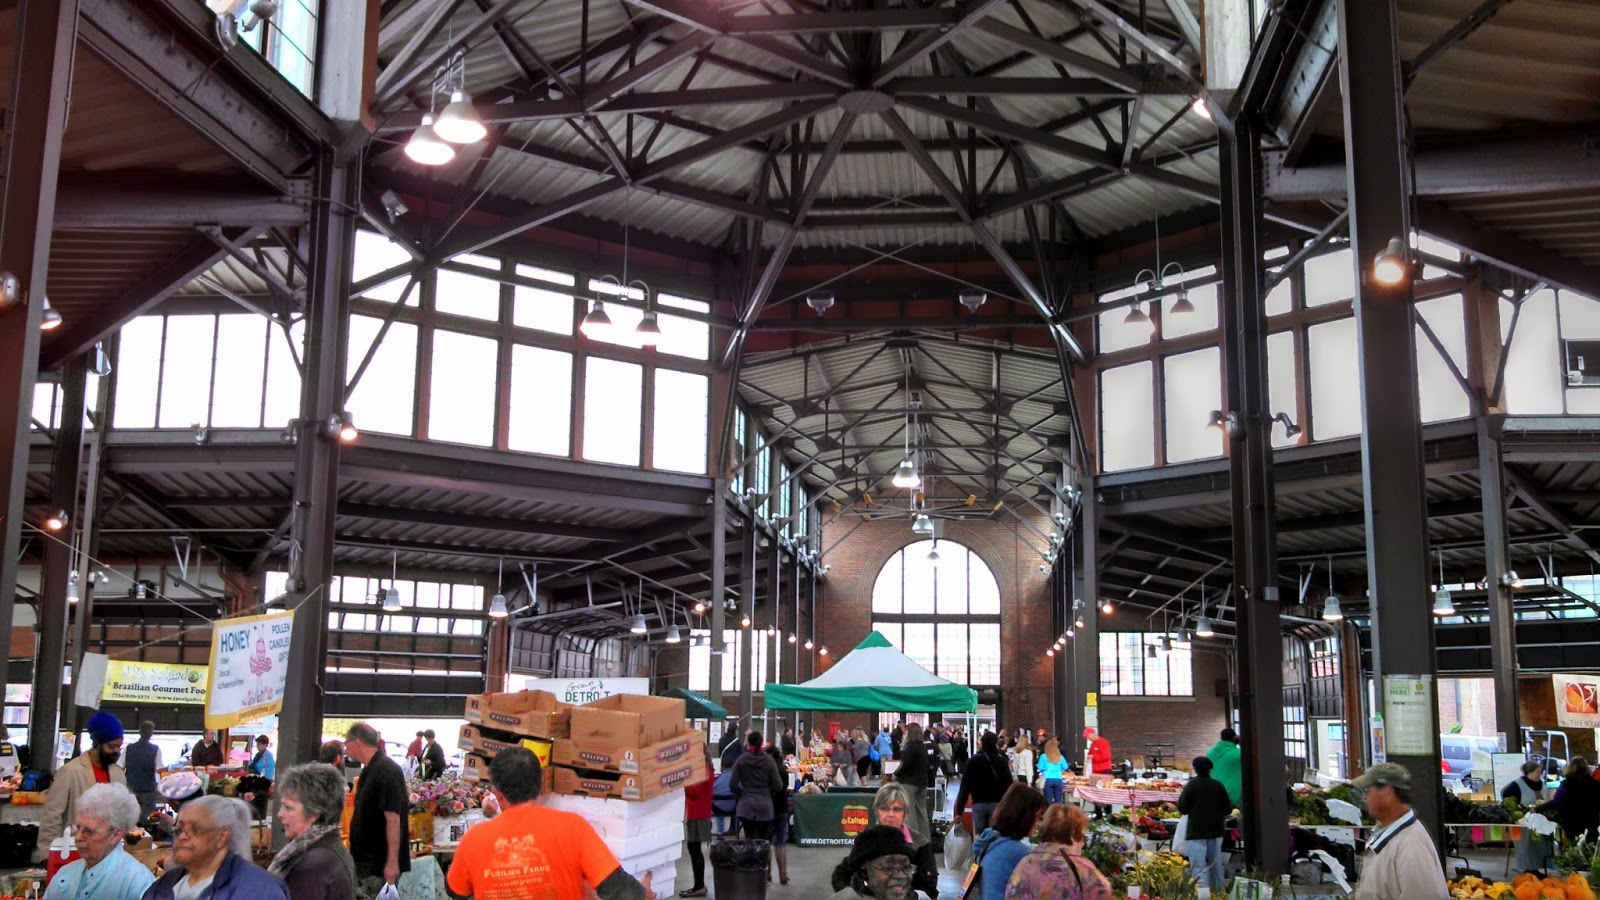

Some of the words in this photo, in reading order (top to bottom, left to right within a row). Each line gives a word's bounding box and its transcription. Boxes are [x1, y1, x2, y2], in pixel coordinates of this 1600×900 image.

[271, 624, 290, 634] POLLEN
[220, 629, 251, 653] HONEY
[113, 681, 150, 692] Brazilian
[152, 684, 189, 694] Gourmet
[190, 686, 206, 695] Foo
[565, 691, 611, 702] DETROT
